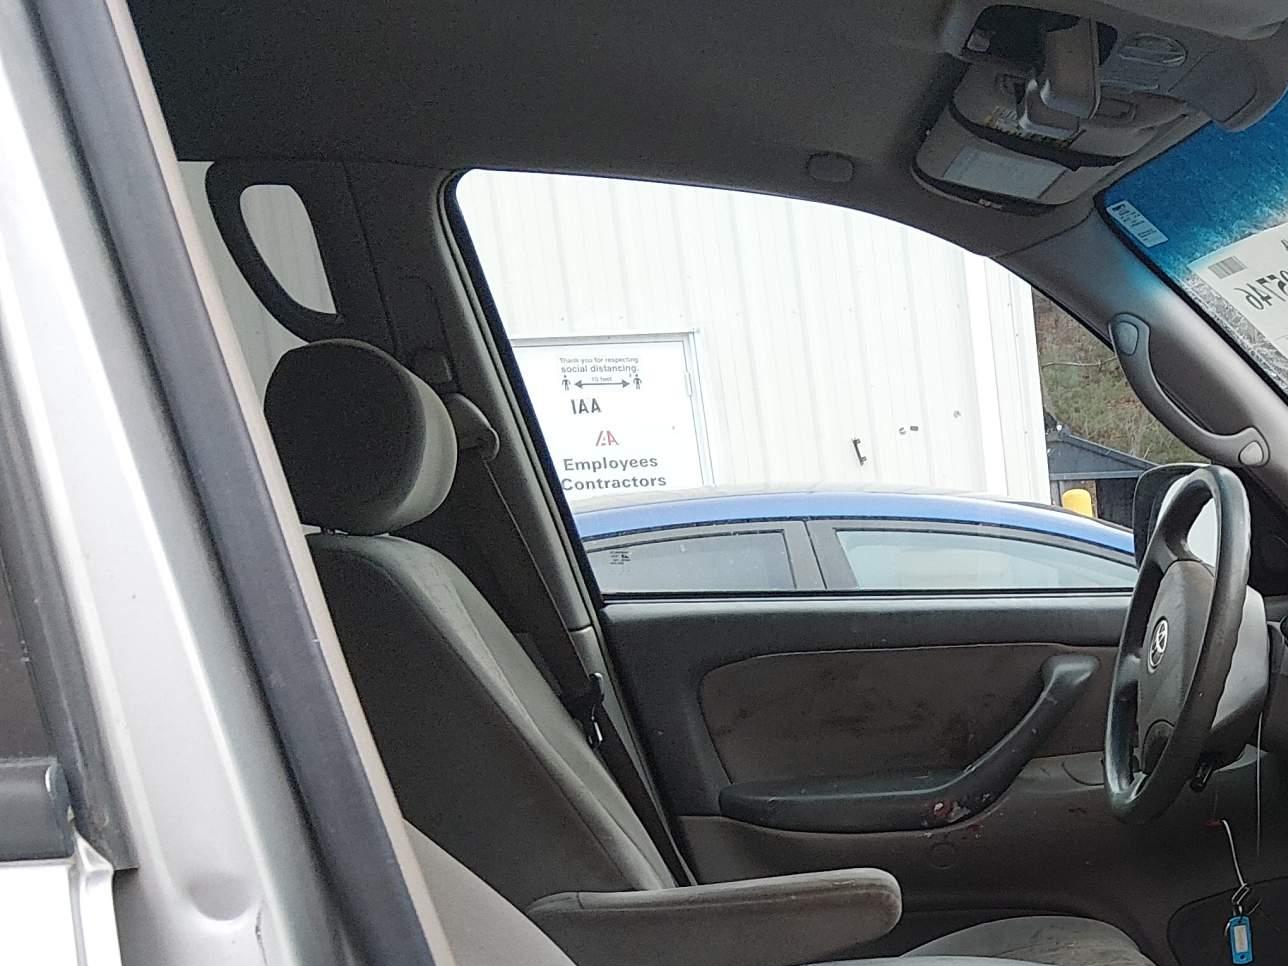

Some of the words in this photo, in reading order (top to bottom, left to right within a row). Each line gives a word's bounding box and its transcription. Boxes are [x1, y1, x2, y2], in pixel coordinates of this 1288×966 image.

[561, 365, 588, 373] social
[571, 398, 602, 415] IAA
[563, 457, 658, 472] Employees
[561, 475, 667, 491] Contractors
